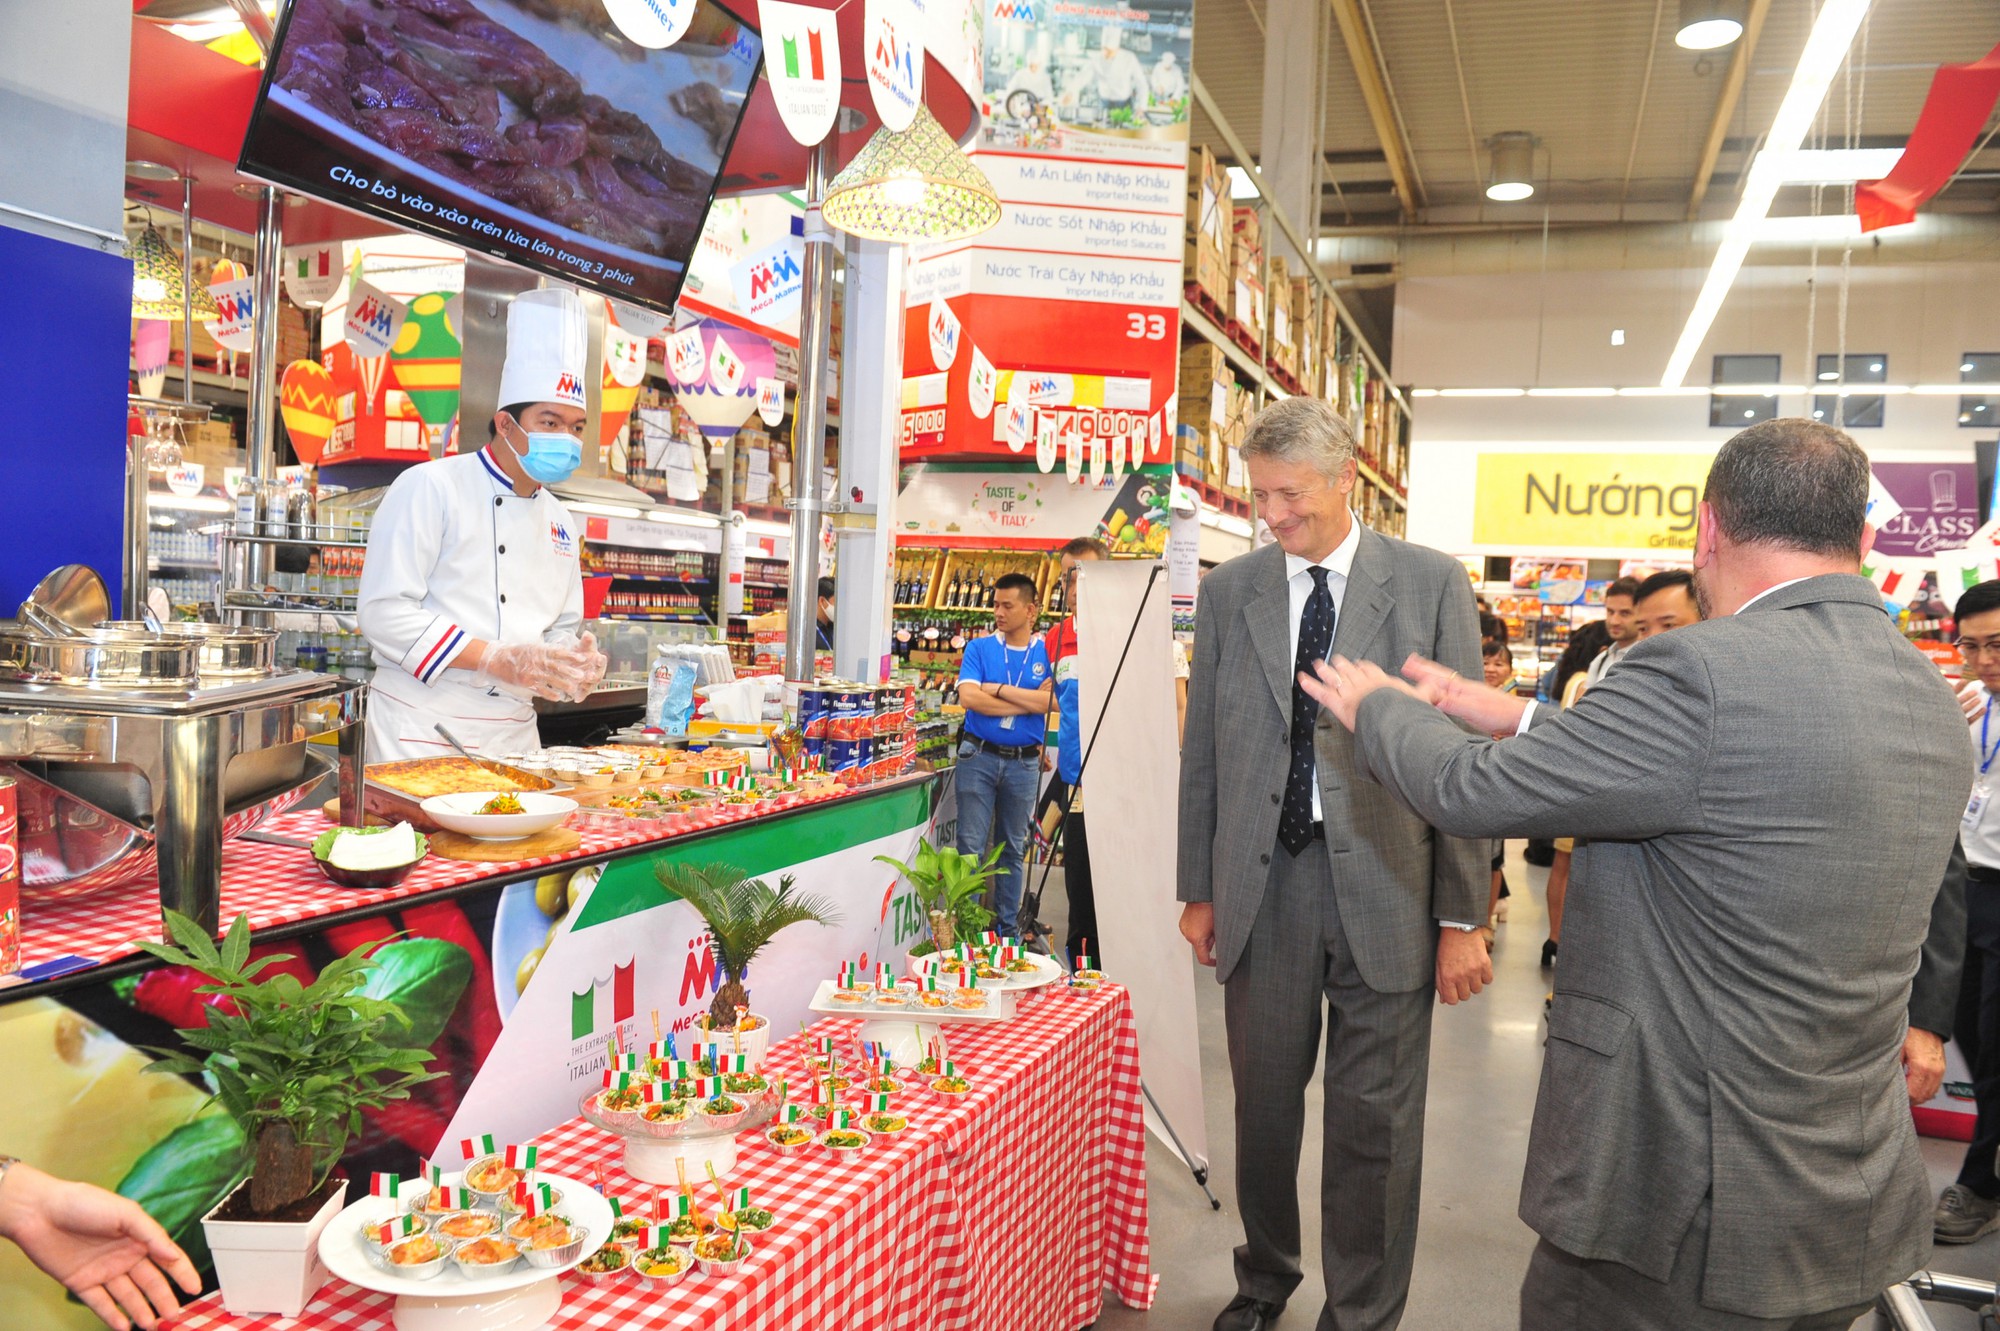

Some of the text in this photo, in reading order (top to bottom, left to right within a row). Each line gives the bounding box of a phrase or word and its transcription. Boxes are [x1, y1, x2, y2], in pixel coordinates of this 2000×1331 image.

[1086, 188, 1130, 202] Imported
[329, 166, 635, 286] Cho bò vào xào trên lửa lớn trong 3 phút
[1085, 235, 1167, 251] Imported Sauces
[1066, 286, 1165, 302] Imported Fruit Juice
[1126, 312, 1167, 341] 33
[986, 486, 1016, 499] TASTE
[1525, 472, 1699, 531] Nướng
[1002, 501, 1015, 513] OF
[1001, 515, 1028, 527] ITALY
[1880, 515, 1975, 536] CLASS
[936, 819, 957, 846] TAST
[893, 892, 921, 946] TAS
[571, 1047, 584, 1057] THE
[584, 1023, 634, 1052] EXTRAORDARY
[570, 1055, 606, 1082] ITALIAN
